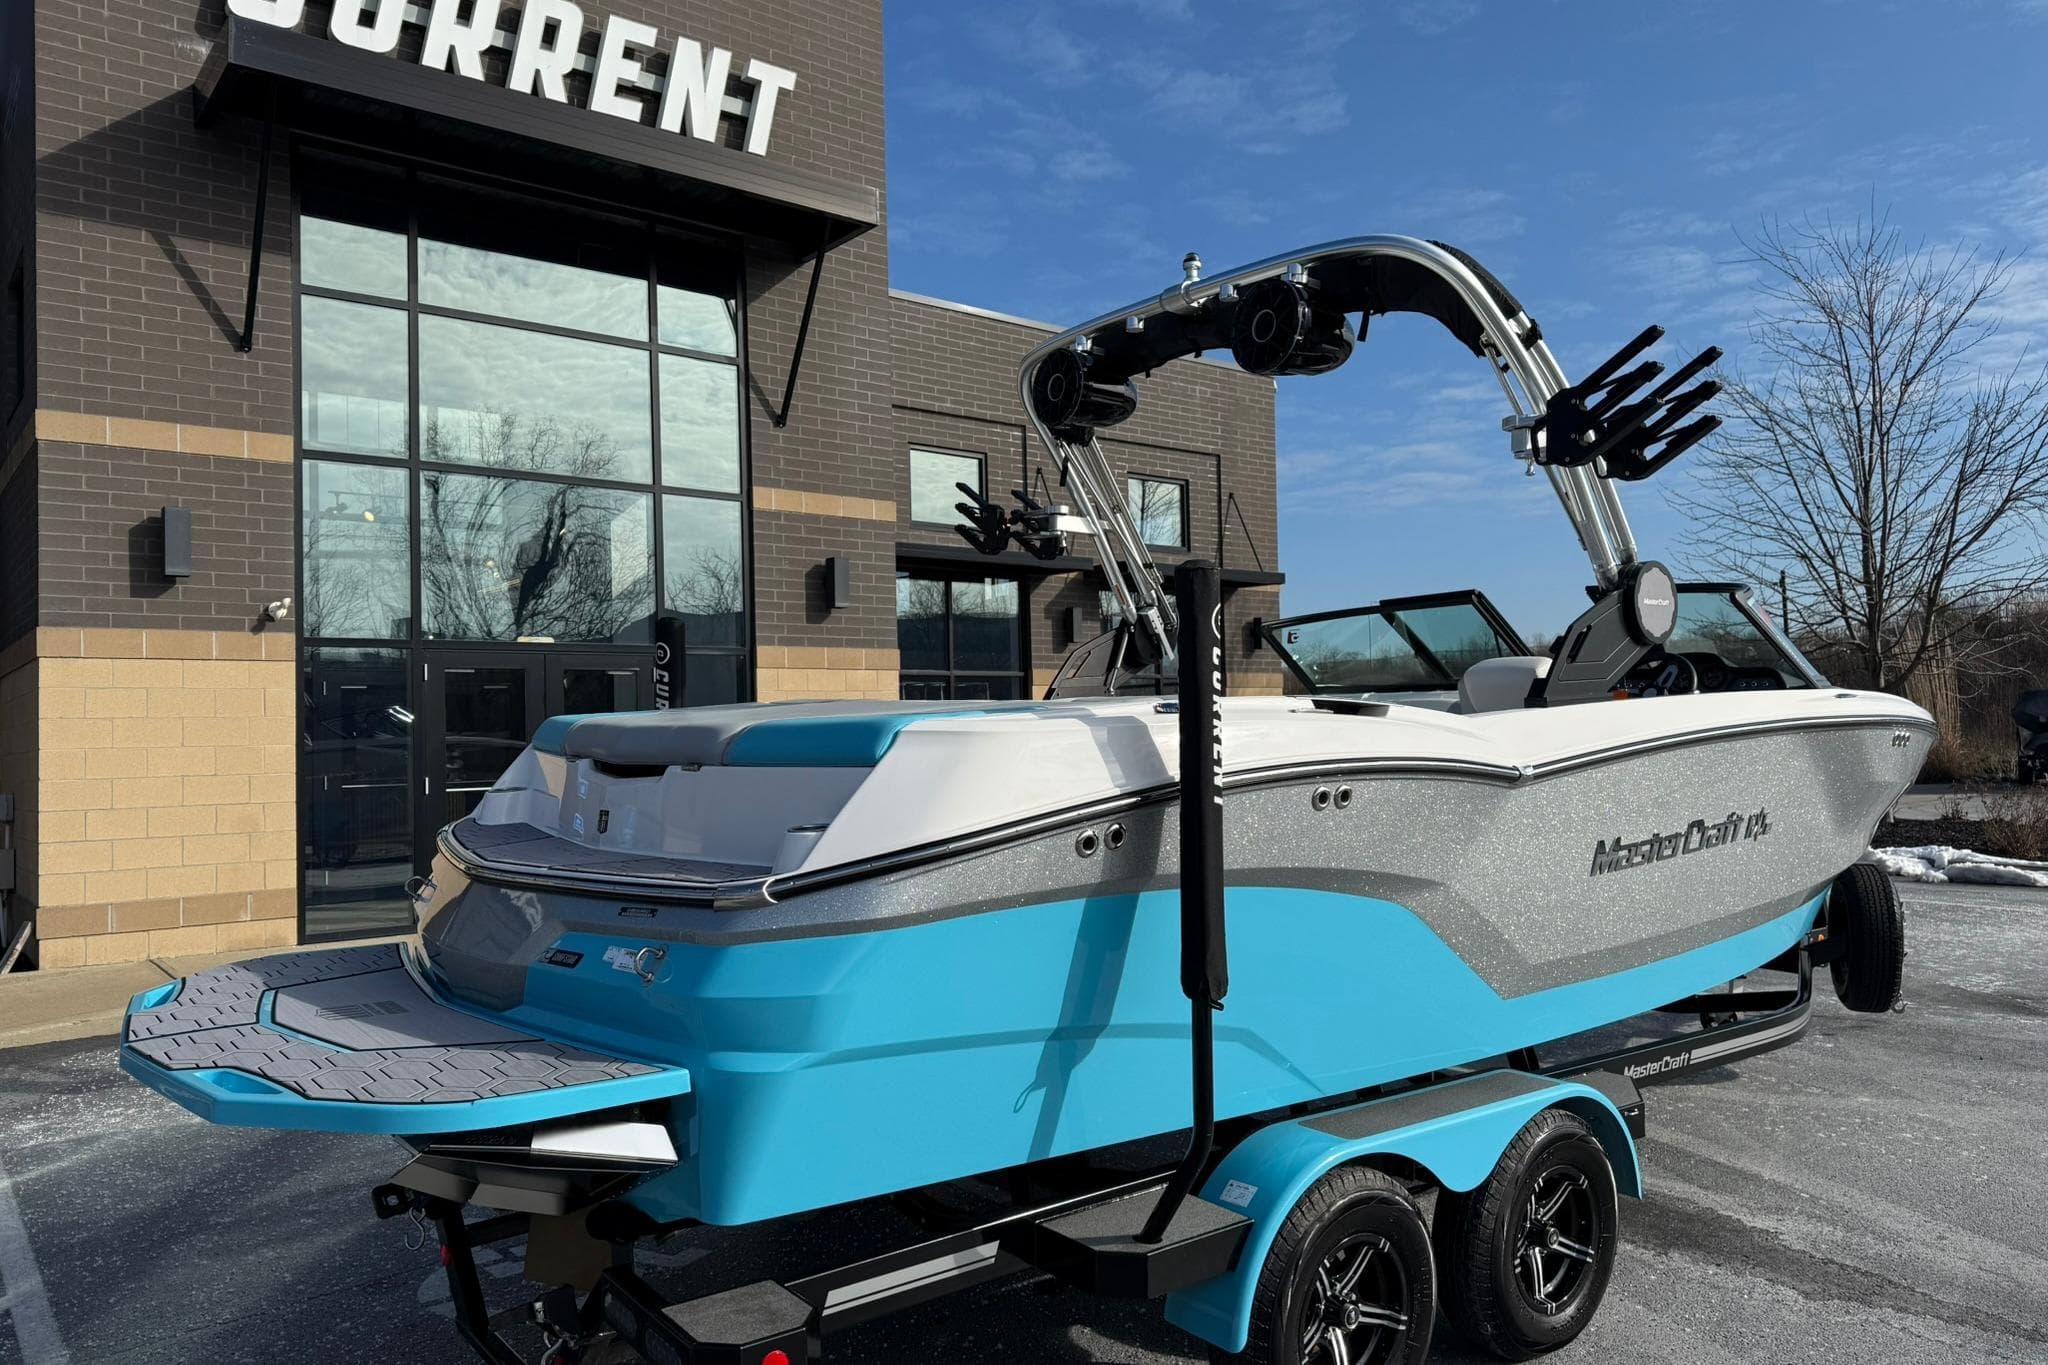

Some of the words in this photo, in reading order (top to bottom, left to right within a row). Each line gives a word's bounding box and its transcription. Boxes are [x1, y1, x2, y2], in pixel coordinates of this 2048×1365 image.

[227, 0, 797, 156] URRENT
[1589, 811, 1745, 877] MasterCraft
[1623, 1051, 1690, 1079] MasterCraft
